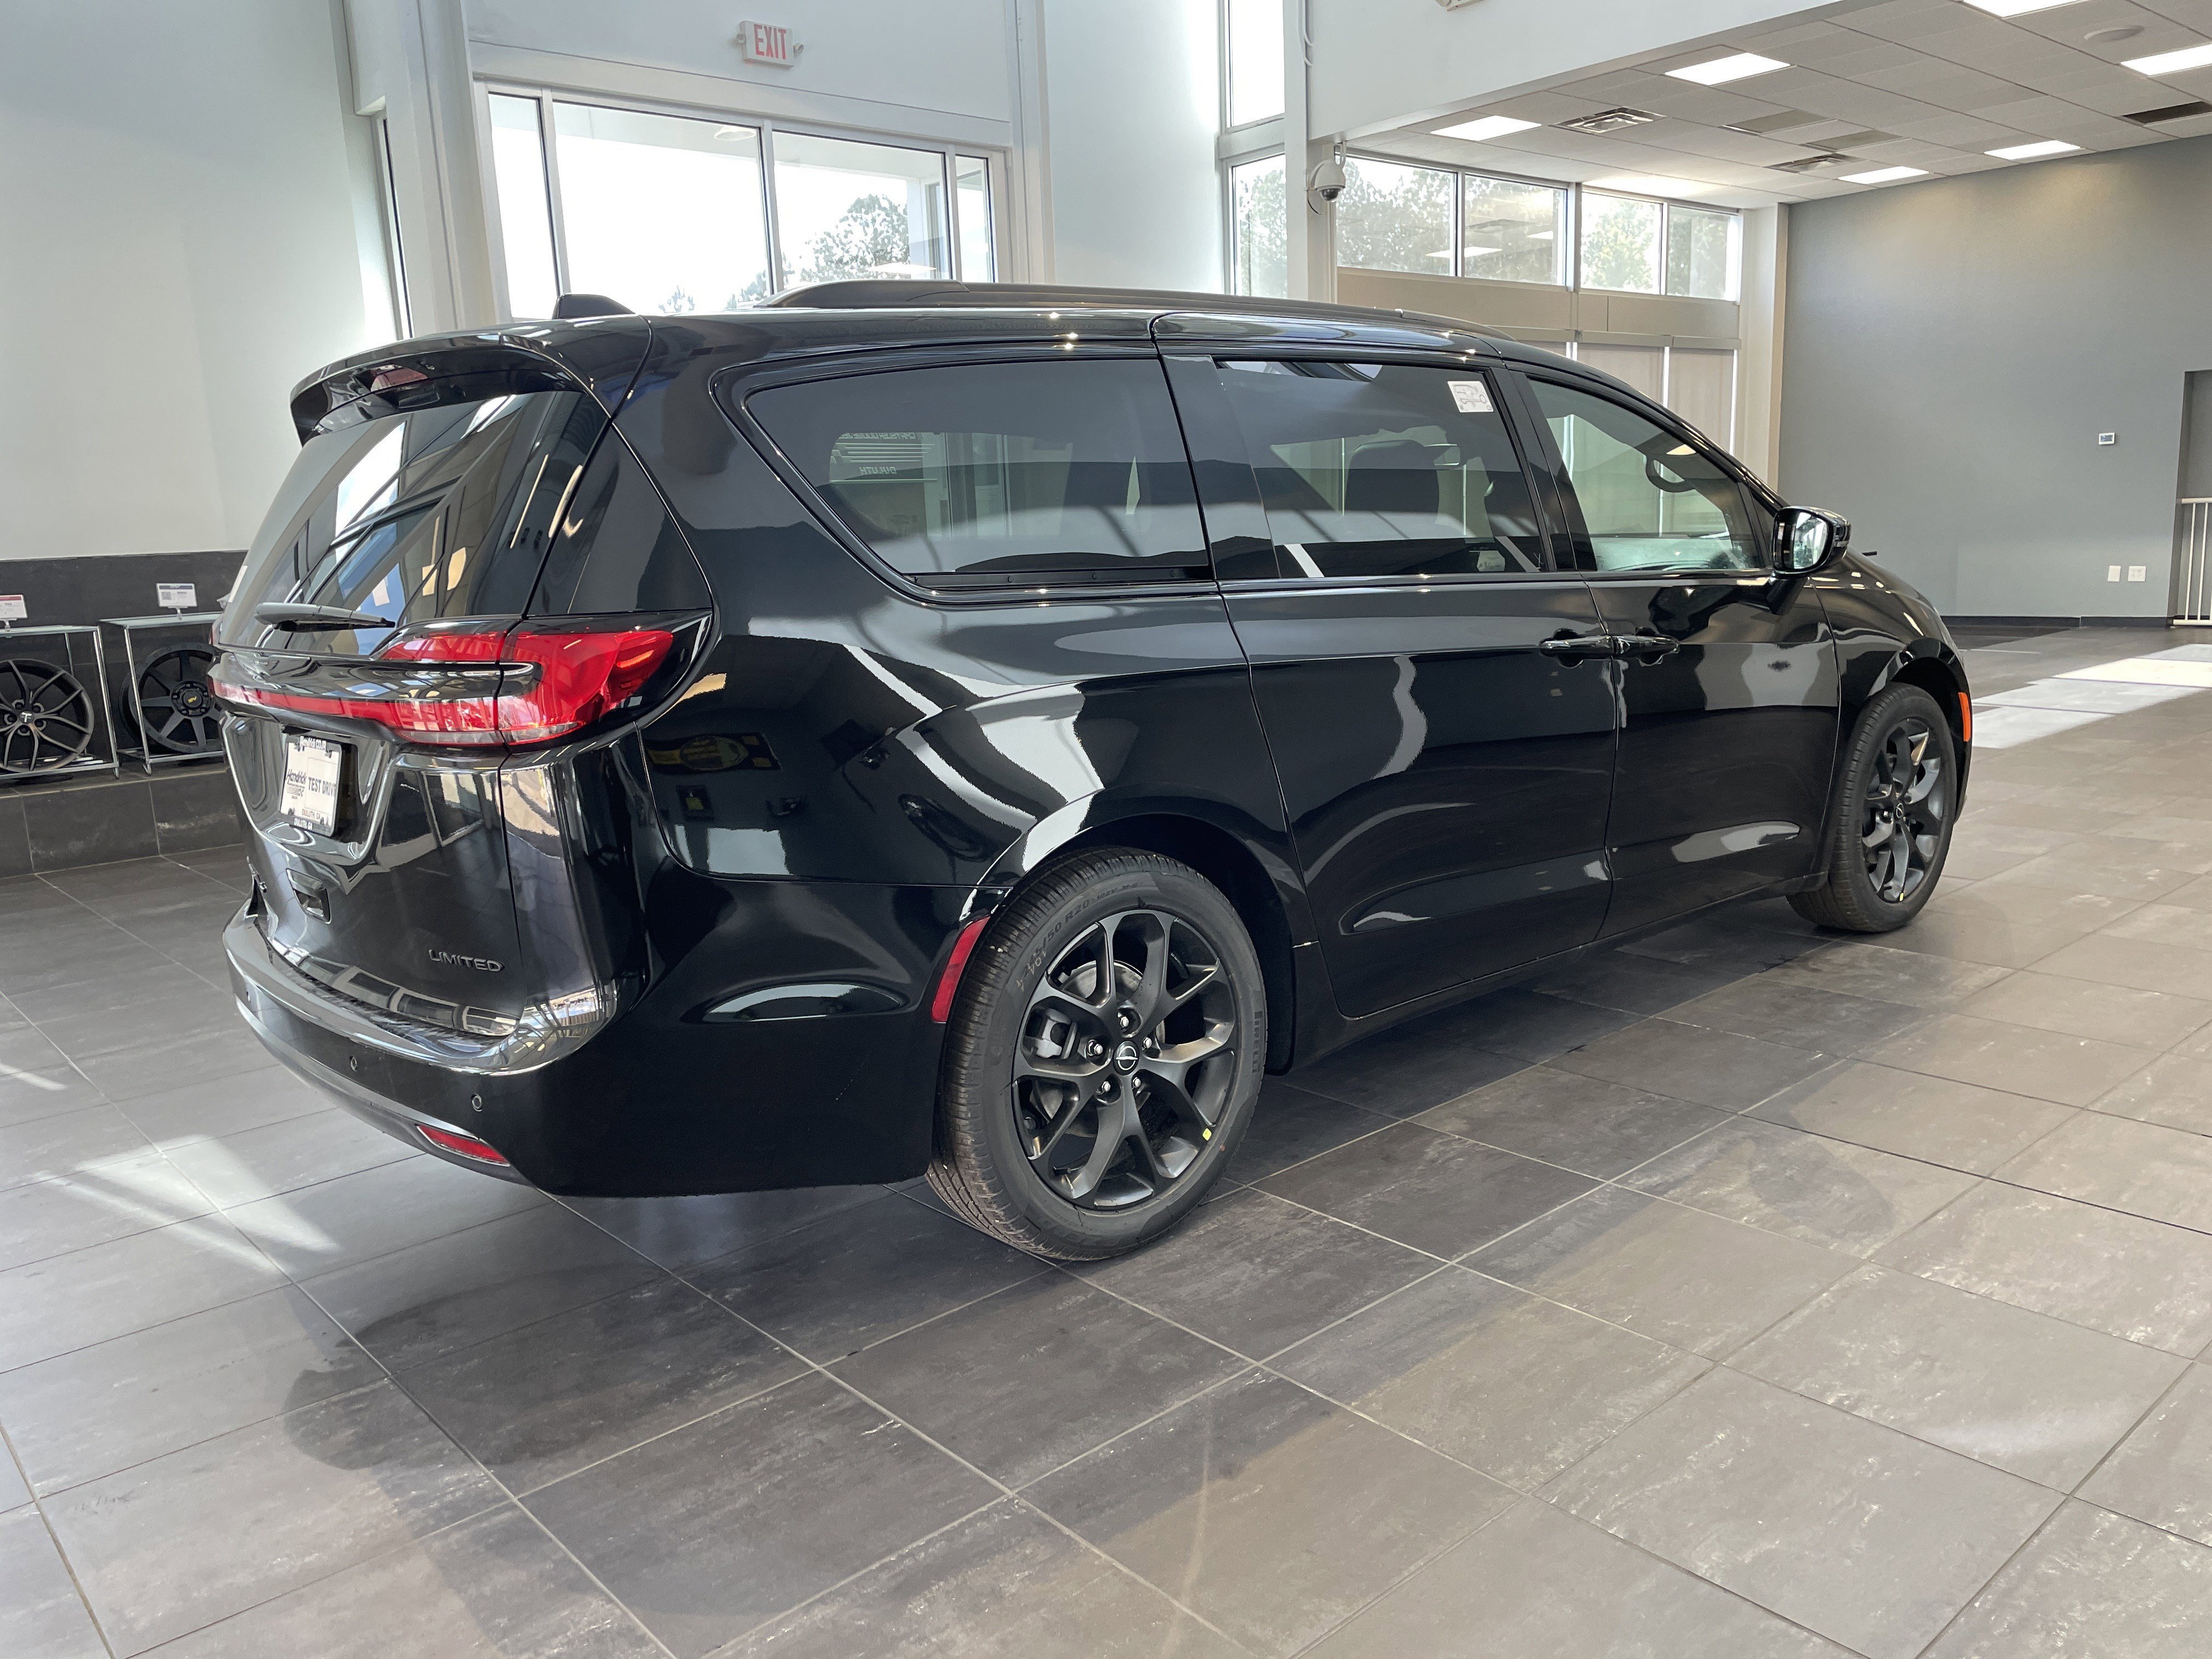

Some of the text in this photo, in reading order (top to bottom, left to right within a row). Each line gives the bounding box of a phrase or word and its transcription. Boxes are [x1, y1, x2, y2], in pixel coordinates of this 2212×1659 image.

[753, 24, 787, 60] EXIT
[285, 769, 307, 785] Hendrick
[308, 776, 321, 793] TEST
[1065, 899, 1090, 923] R20
[428, 949, 505, 972] LIMITED
